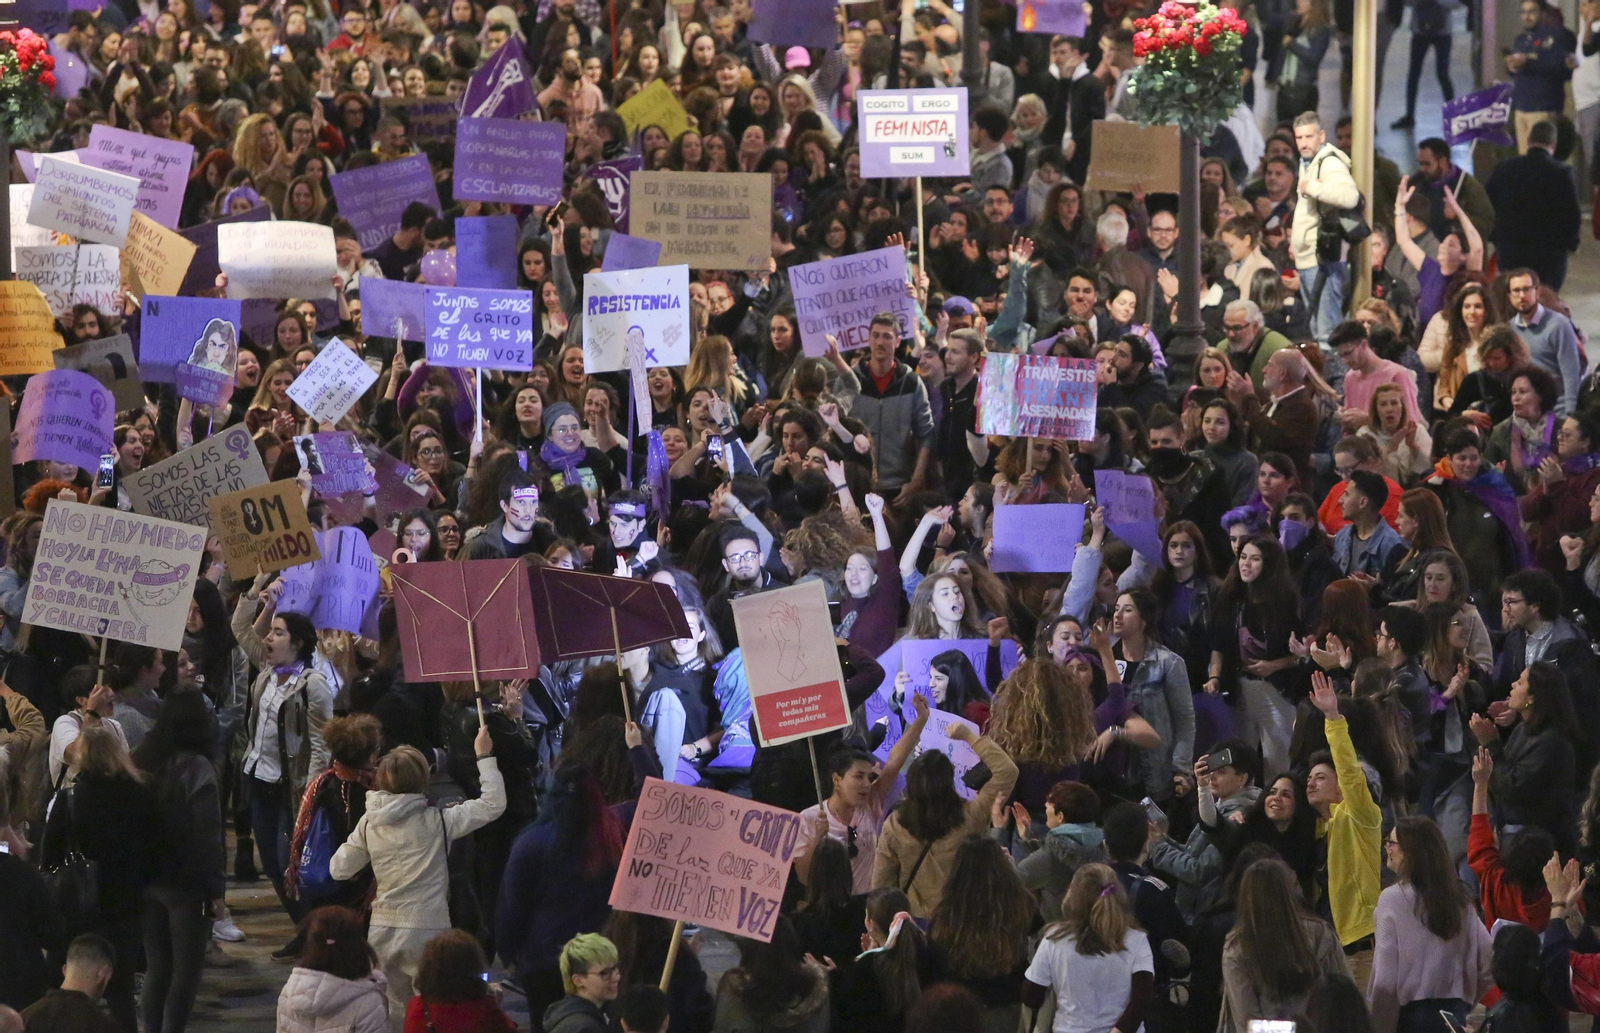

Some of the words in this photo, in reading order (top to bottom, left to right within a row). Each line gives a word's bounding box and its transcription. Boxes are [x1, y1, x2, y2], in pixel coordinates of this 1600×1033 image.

[874, 119, 949, 137] FEMINISTA
[901, 152, 923, 160] SUM
[87, 252, 107, 266] LA
[830, 255, 889, 282] QUITARON
[489, 298, 532, 313] SOMOS
[588, 293, 681, 316] RESISTENCIA
[795, 292, 833, 315] TANTO
[836, 287, 859, 304] QUE
[890, 299, 909, 313] EL
[439, 307, 461, 325] el
[473, 311, 522, 326] GRITO
[432, 326, 451, 340] DE
[458, 323, 482, 342] las
[515, 330, 533, 344] YA
[835, 324, 871, 348] MIED
[432, 342, 449, 358] NO
[493, 349, 526, 363] VOZ
[1066, 358, 1096, 370] LAS
[289, 387, 301, 397] EL
[304, 361, 322, 380] MIEDO
[324, 341, 340, 359] NUNCA
[319, 365, 331, 379] SER
[1023, 365, 1096, 383] TRAVESTIS
[304, 382, 330, 410] GRANDE
[330, 367, 344, 383] QUE
[344, 358, 354, 367] EL
[312, 401, 328, 417] AMOR
[326, 391, 335, 401] DE
[335, 379, 347, 391] LAS
[347, 360, 364, 377] TUYAS
[333, 376, 365, 412] CUIDARTE
[1022, 390, 1094, 408] TRANS
[46, 413, 83, 427] QUIEREN
[1020, 402, 1095, 421] ASESINADAS
[44, 432, 74, 445] TIENEN
[137, 461, 190, 496] SOMOS
[191, 446, 221, 471] LAS
[146, 480, 194, 515] NIETAS
[193, 471, 213, 493] DE
[215, 458, 241, 483] LAS
[241, 494, 291, 536] 8M
[45, 507, 87, 536] NO
[87, 514, 142, 544] HAY
[139, 523, 204, 551] MIEDO
[40, 538, 80, 564] HOY
[78, 546, 95, 562] LA
[95, 548, 141, 575] LUNA
[264, 531, 312, 563] MIEDO
[33, 562, 66, 587] SE
[65, 570, 115, 597] QUEDA
[31, 585, 120, 616] BORRACHA
[29, 602, 46, 623] Y
[45, 607, 147, 643] CALLEJERA
[775, 700, 790, 709] Por
[808, 694, 822, 704] por
[782, 707, 804, 717] todas
[804, 704, 819, 712] mis
[778, 712, 827, 727] compañeras
[642, 785, 726, 831] SOMOS
[739, 808, 801, 864] GRITO
[633, 827, 673, 860] DE
[676, 836, 711, 874] las
[717, 851, 759, 881] QUE
[756, 862, 781, 890] YA
[628, 857, 654, 879] NO
[650, 864, 736, 922] TIENEN
[736, 885, 781, 939] VOZ
